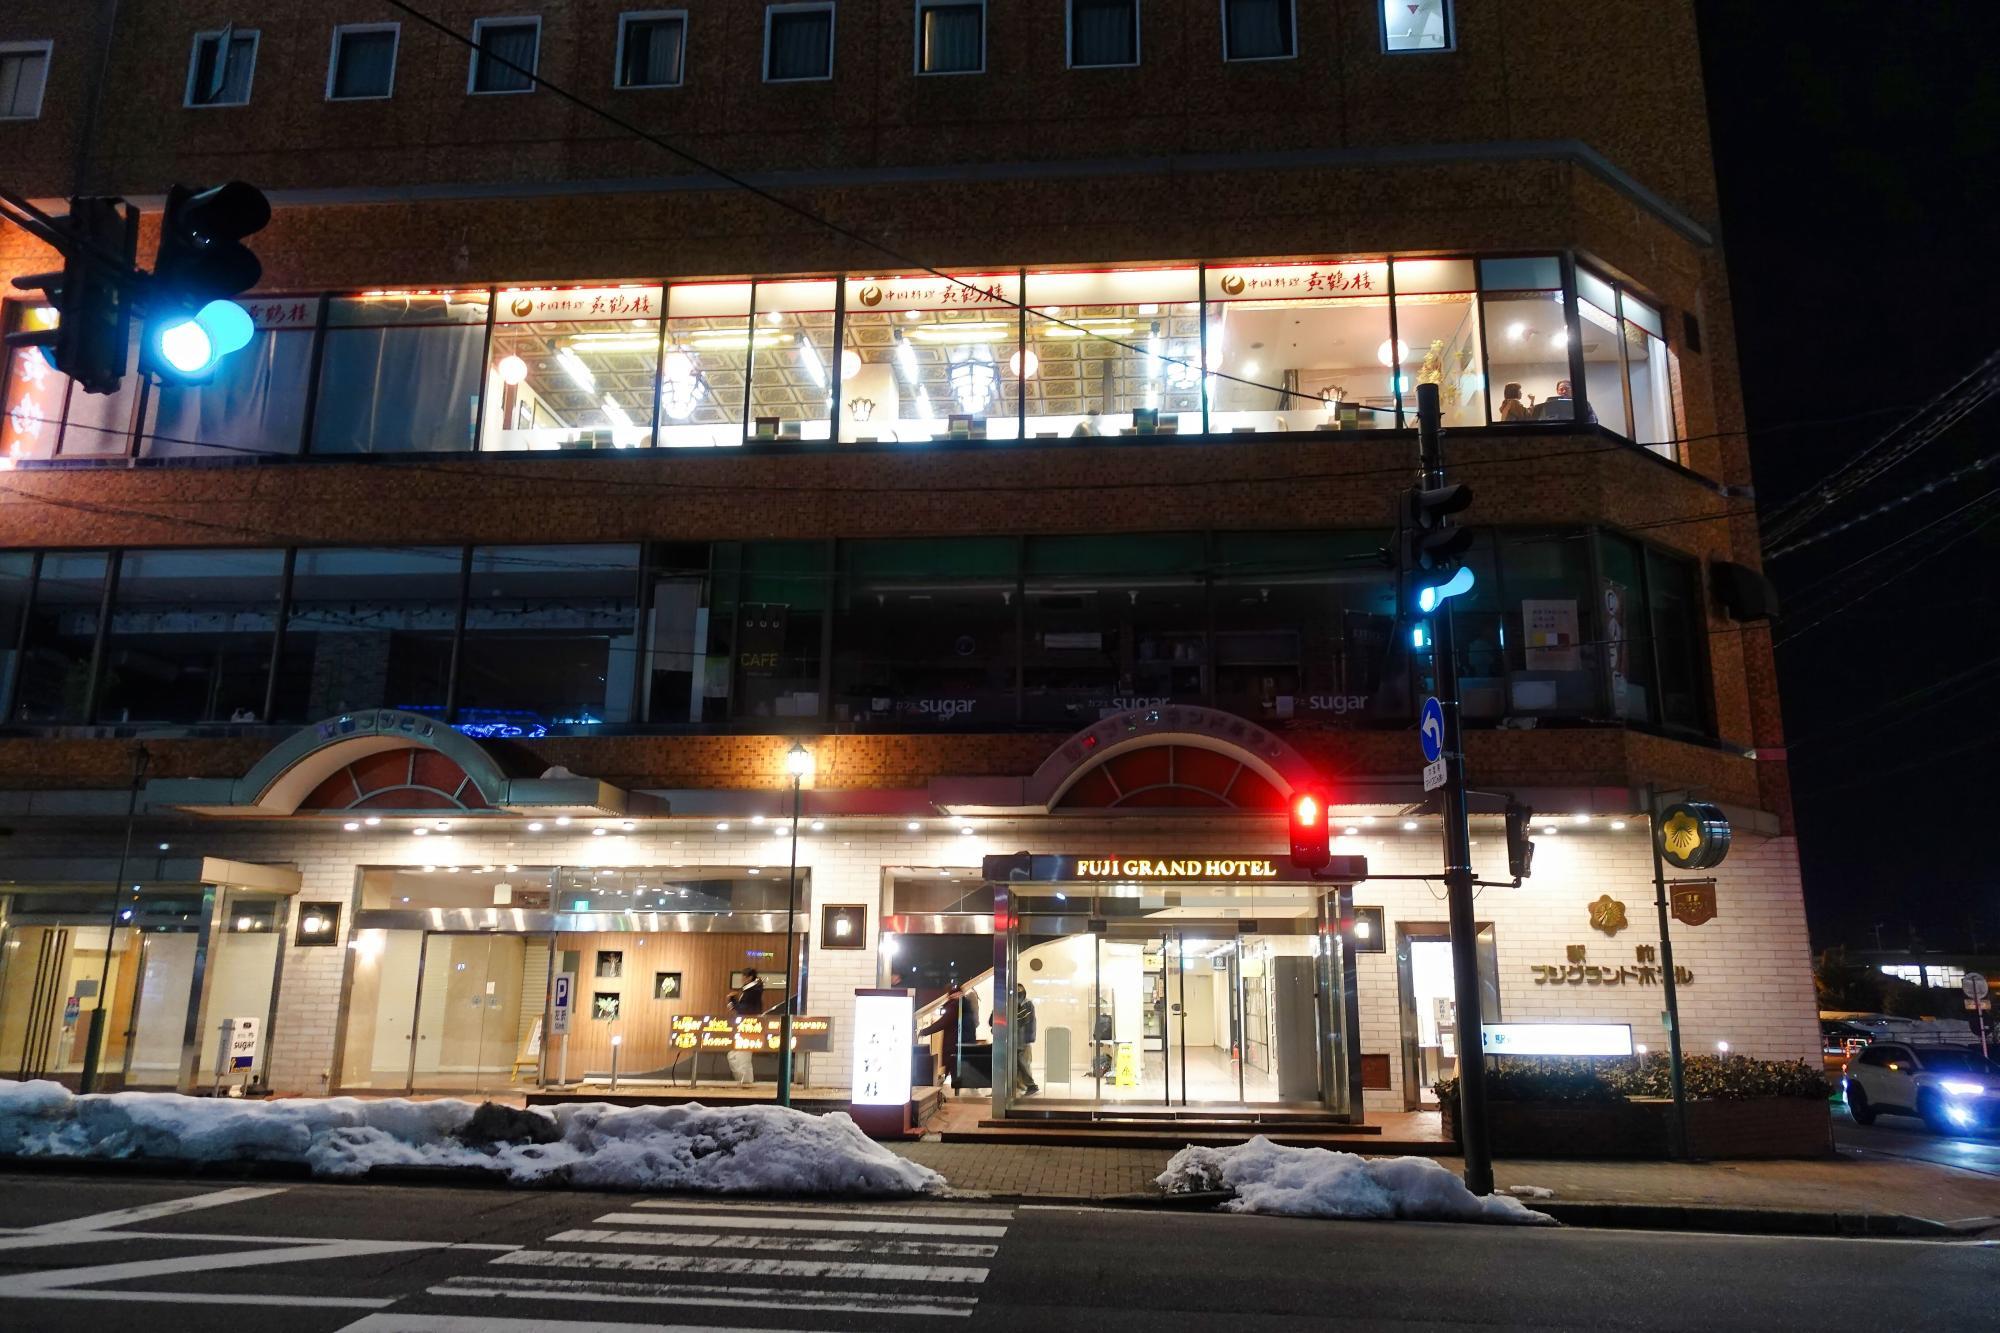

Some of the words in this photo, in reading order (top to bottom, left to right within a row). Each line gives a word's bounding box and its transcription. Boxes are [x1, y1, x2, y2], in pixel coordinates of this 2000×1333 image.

[1247, 277, 1300, 289] 中国料理
[919, 699, 976, 719] sugar
[1309, 695, 1369, 715] sugar
[1077, 860, 1119, 876] FUJI
[1122, 860, 1203, 876] GRAND
[1204, 860, 1277, 876] HOTEL
[1531, 964, 1694, 985] フジグランドホル
